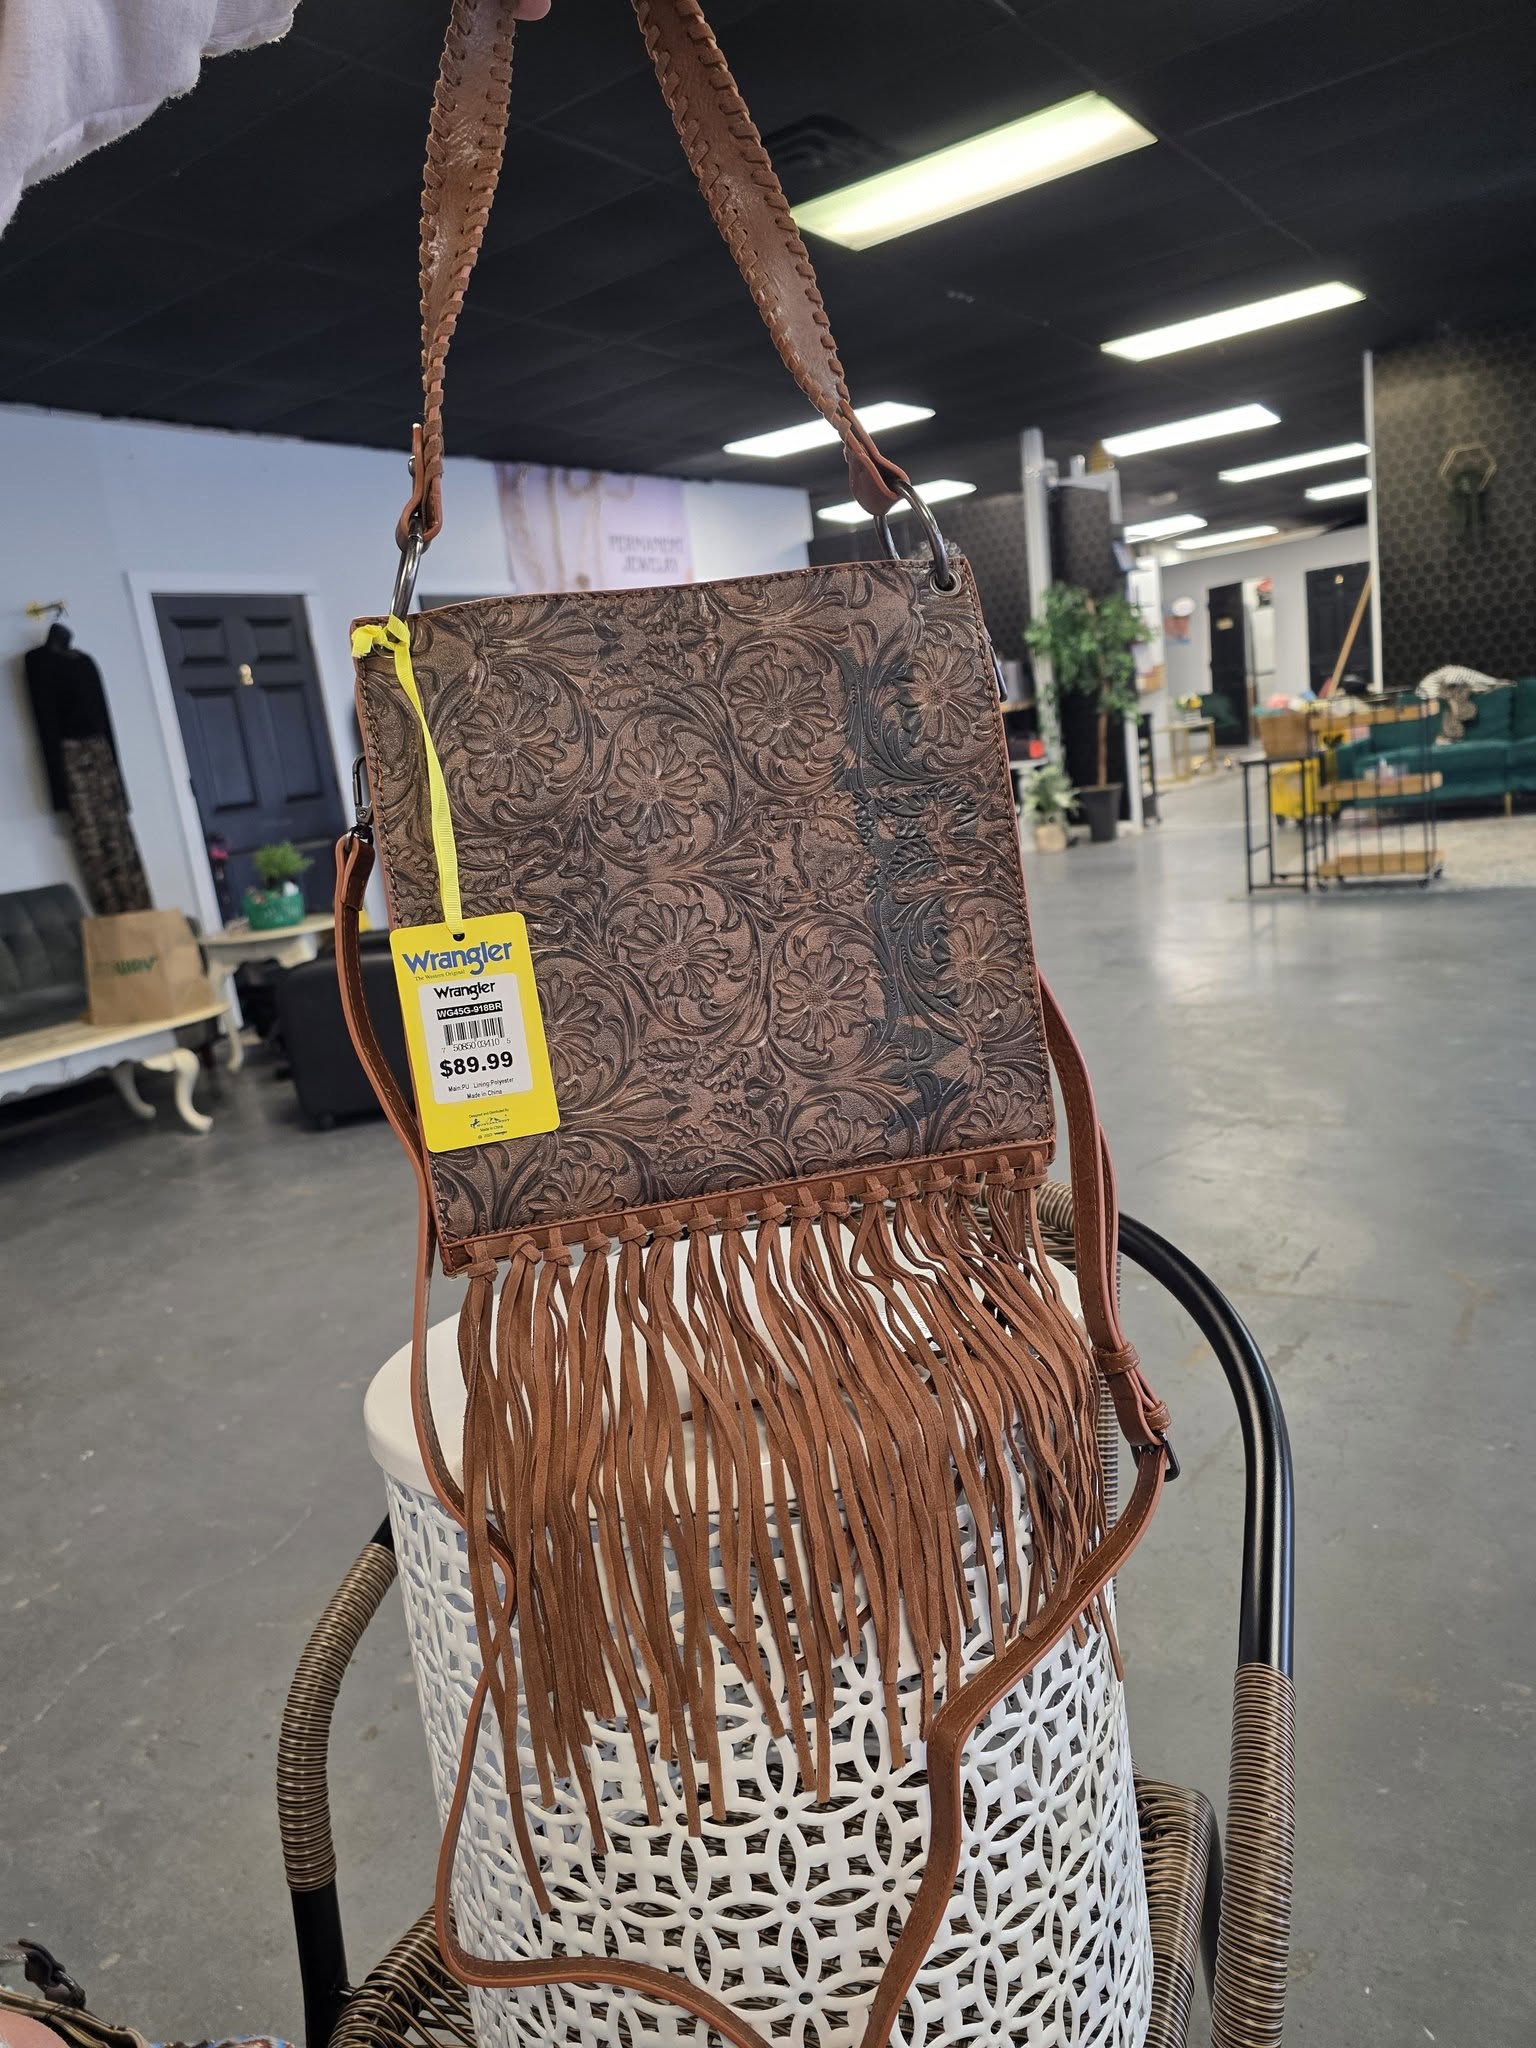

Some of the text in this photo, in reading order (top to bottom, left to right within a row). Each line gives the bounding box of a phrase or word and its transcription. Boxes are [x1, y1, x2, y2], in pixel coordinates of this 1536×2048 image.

[402, 941, 512, 975] Wrangler
[434, 982, 495, 1000] Wrangler
[437, 1002, 502, 1018] WG45G-918BR
[440, 1051, 513, 1079] $89.99
